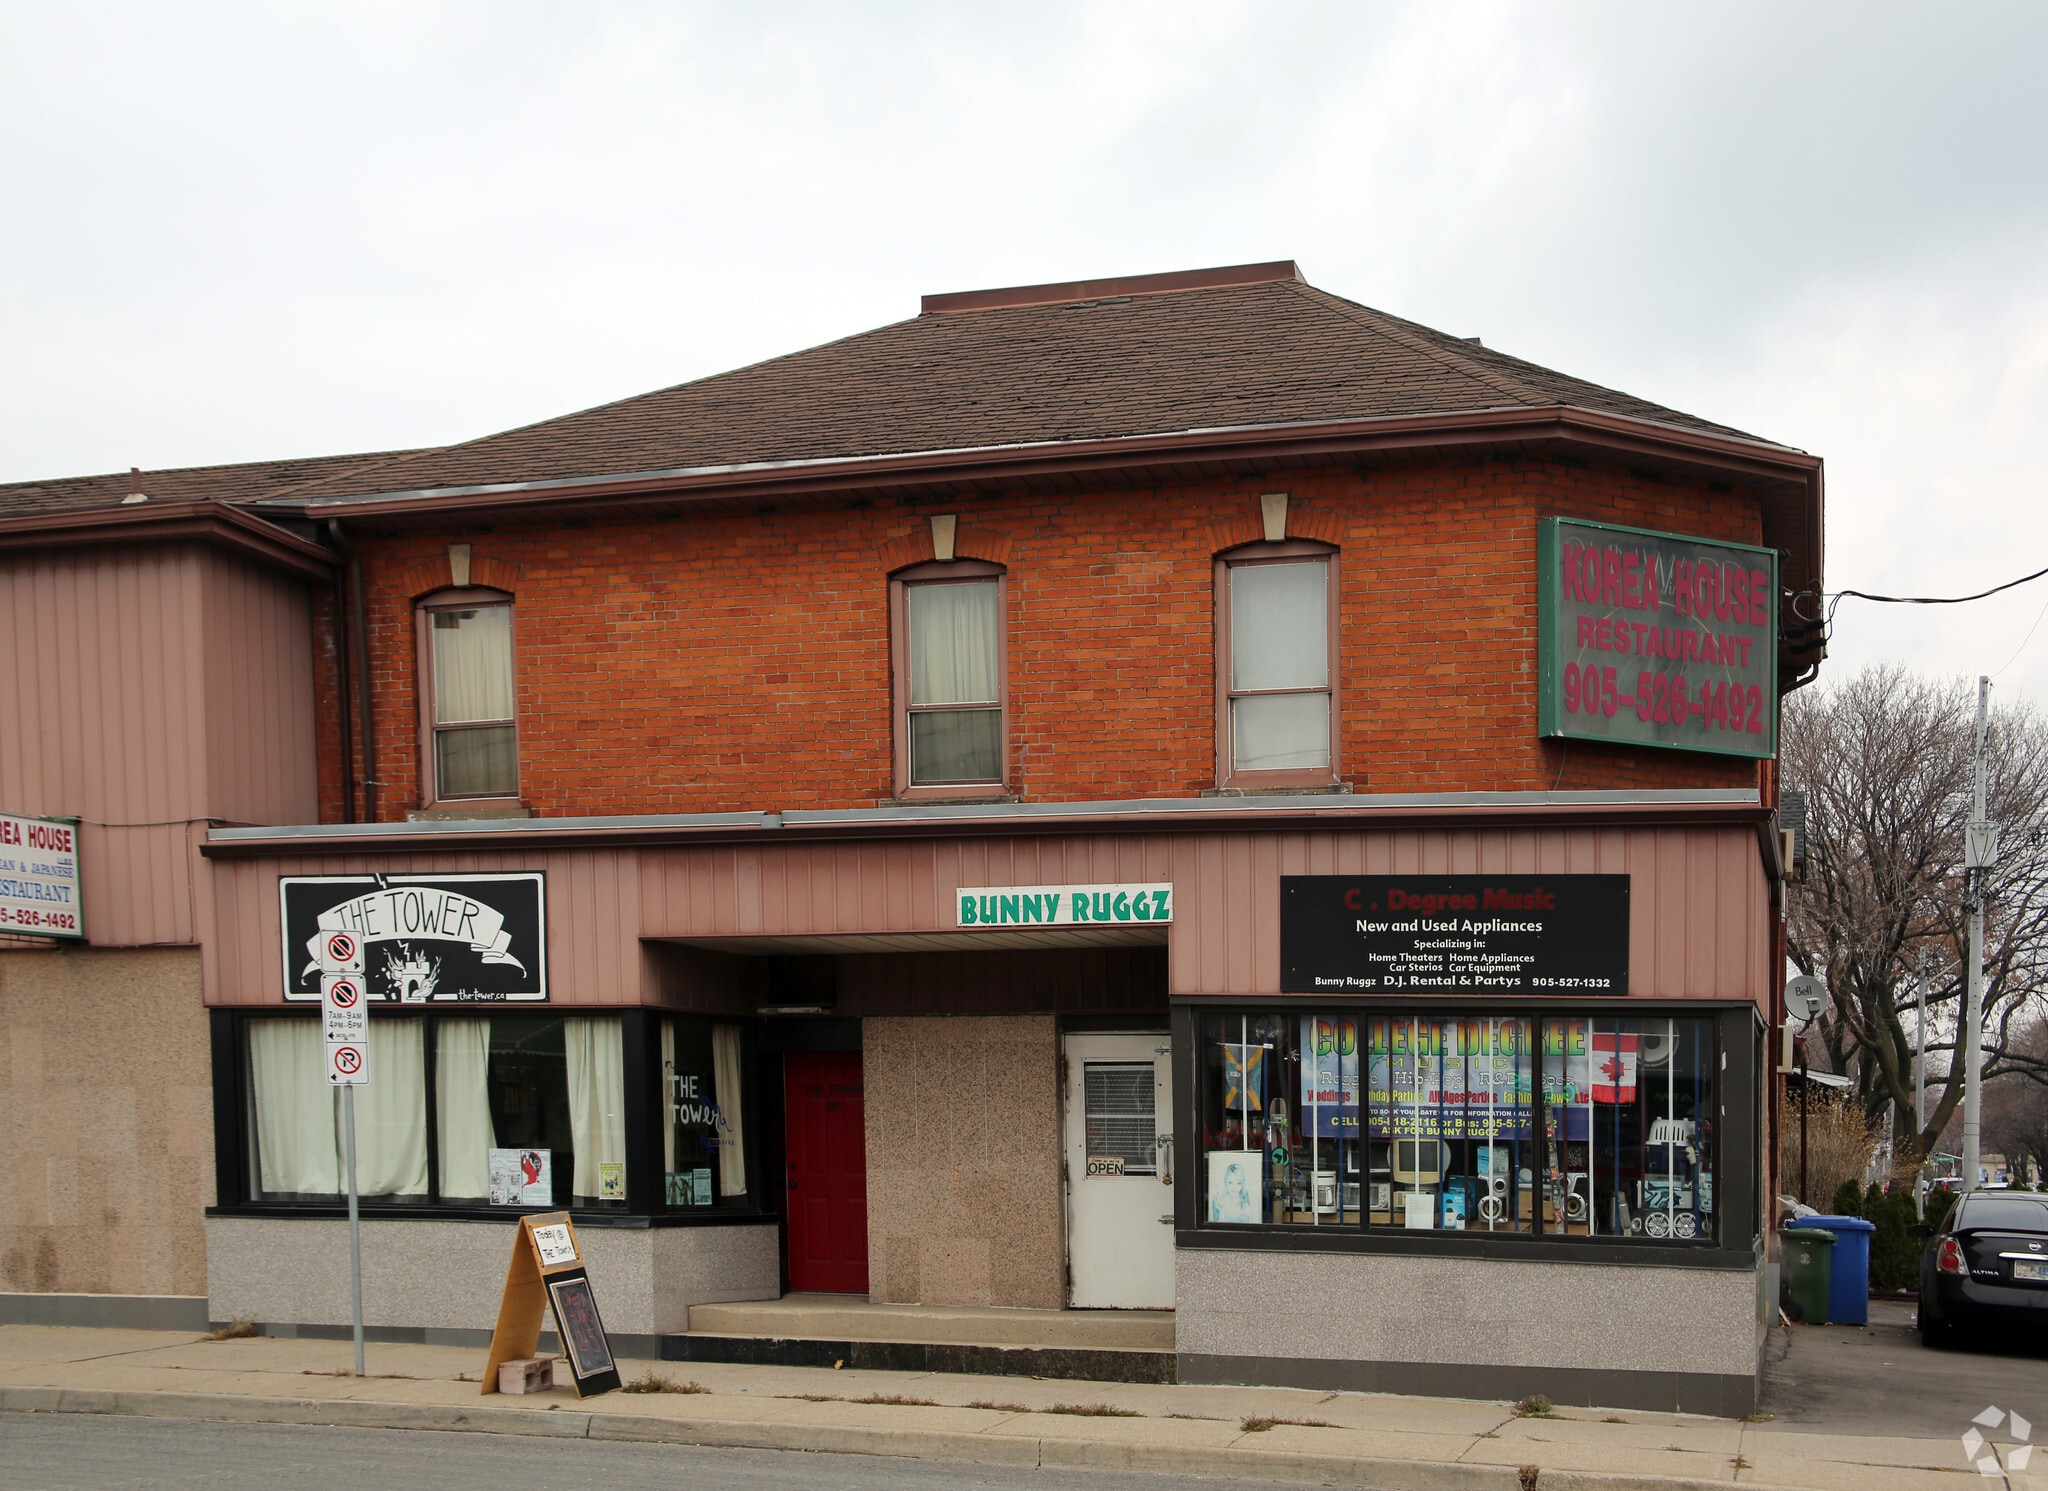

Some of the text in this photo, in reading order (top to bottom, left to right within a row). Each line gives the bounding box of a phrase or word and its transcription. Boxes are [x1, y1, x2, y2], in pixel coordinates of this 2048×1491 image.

[1564, 543, 1767, 627] KOREA HOUSE
[1577, 615, 1754, 669] RESTAURANT
[1564, 661, 1763, 734] 905-526-1492
[28, 824, 72, 853] HOUSE
[31, 863, 74, 878] JAPANESE
[961, 890, 1170, 924] BUNNY RUGGZ
[1388, 889, 1478, 915] Degree
[1482, 889, 1556, 911] Music
[333, 891, 480, 940] THE TOWER
[1356, 919, 1543, 935] New and Used Appliances
[1413, 939, 1486, 951] Specializing in:
[1368, 953, 1443, 963] Home Theaters
[1449, 953, 1535, 964] Home Appliances
[1389, 963, 1443, 972] Car Sterios
[1449, 963, 1521, 975] Car Equipment
[1315, 975, 1610, 988] Bunny Ruggz D.J. Rental & Partys 905-527-1332
[458, 988, 505, 1001] the-tower.ca
[1795, 985, 1812, 996] Bell
[1309, 1020, 1449, 1056] COLEGE
[667, 1075, 699, 1098] THE
[1321, 1071, 1379, 1089] Regge
[1392, 1089, 1424, 1102] Partis
[1443, 1090, 1466, 1104] Ages
[1467, 1090, 1498, 1104] Partis
[1088, 1162, 1124, 1175] OPEN
[1971, 1268, 1999, 1276] ALTIMA
